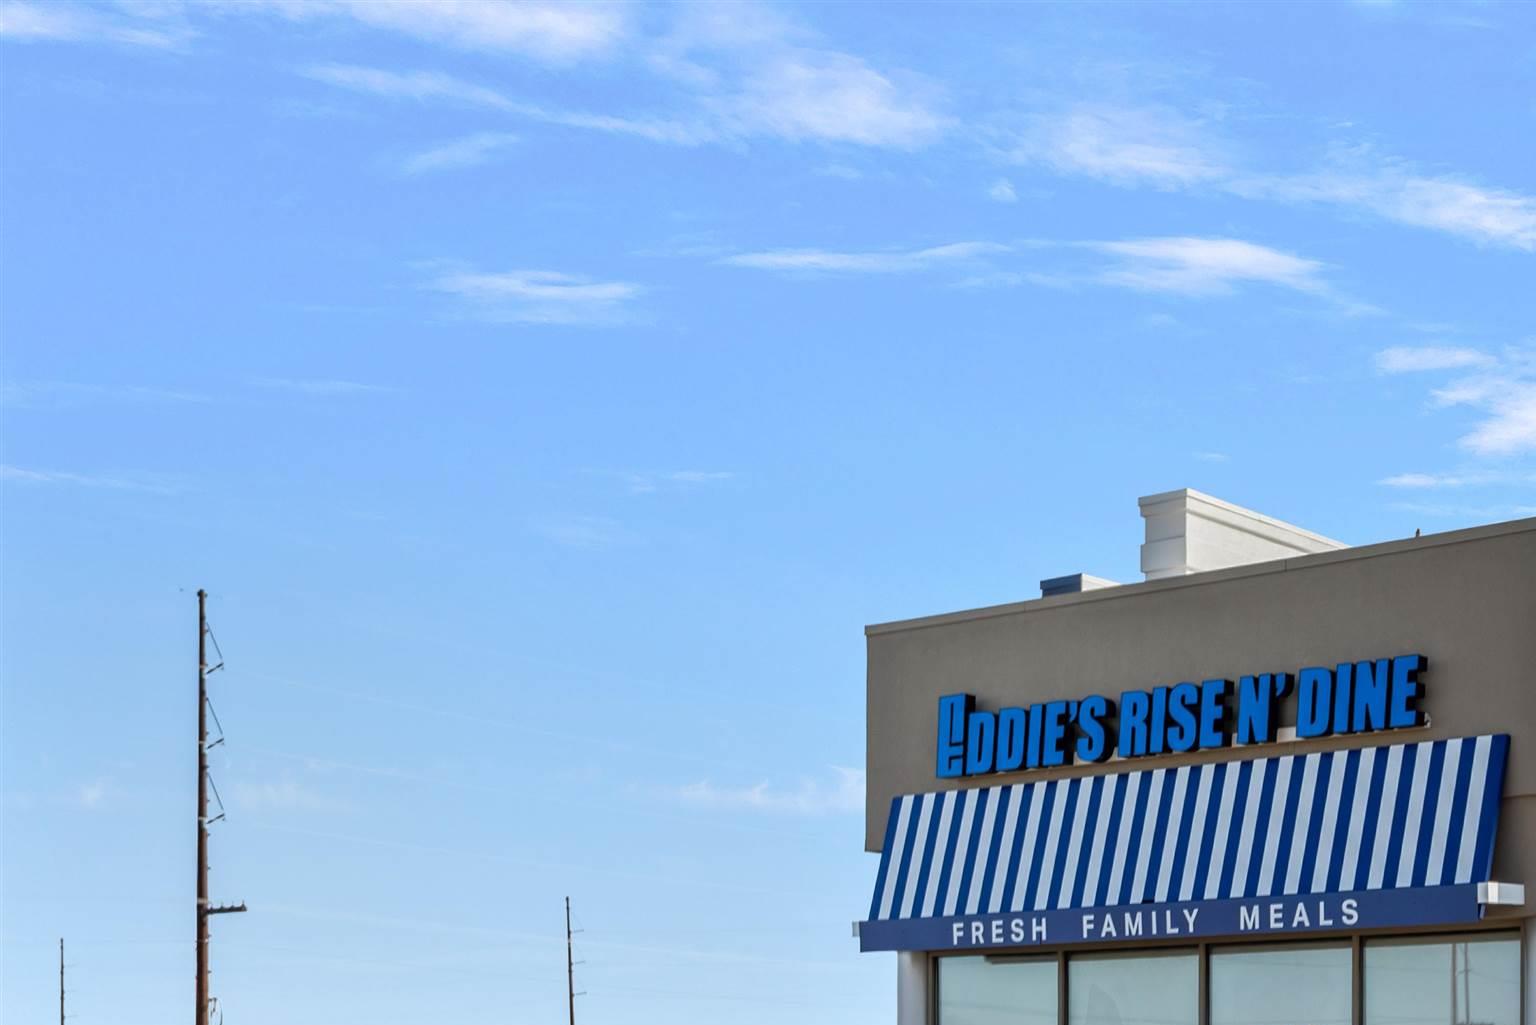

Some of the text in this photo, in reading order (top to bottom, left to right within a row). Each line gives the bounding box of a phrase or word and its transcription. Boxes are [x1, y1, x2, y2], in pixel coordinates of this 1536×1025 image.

[1117, 679, 1229, 758] RISE
[1236, 671, 1291, 745] N'
[1296, 654, 1423, 738] DINE
[952, 898, 1359, 946] FRESH FAMILY MEALS
